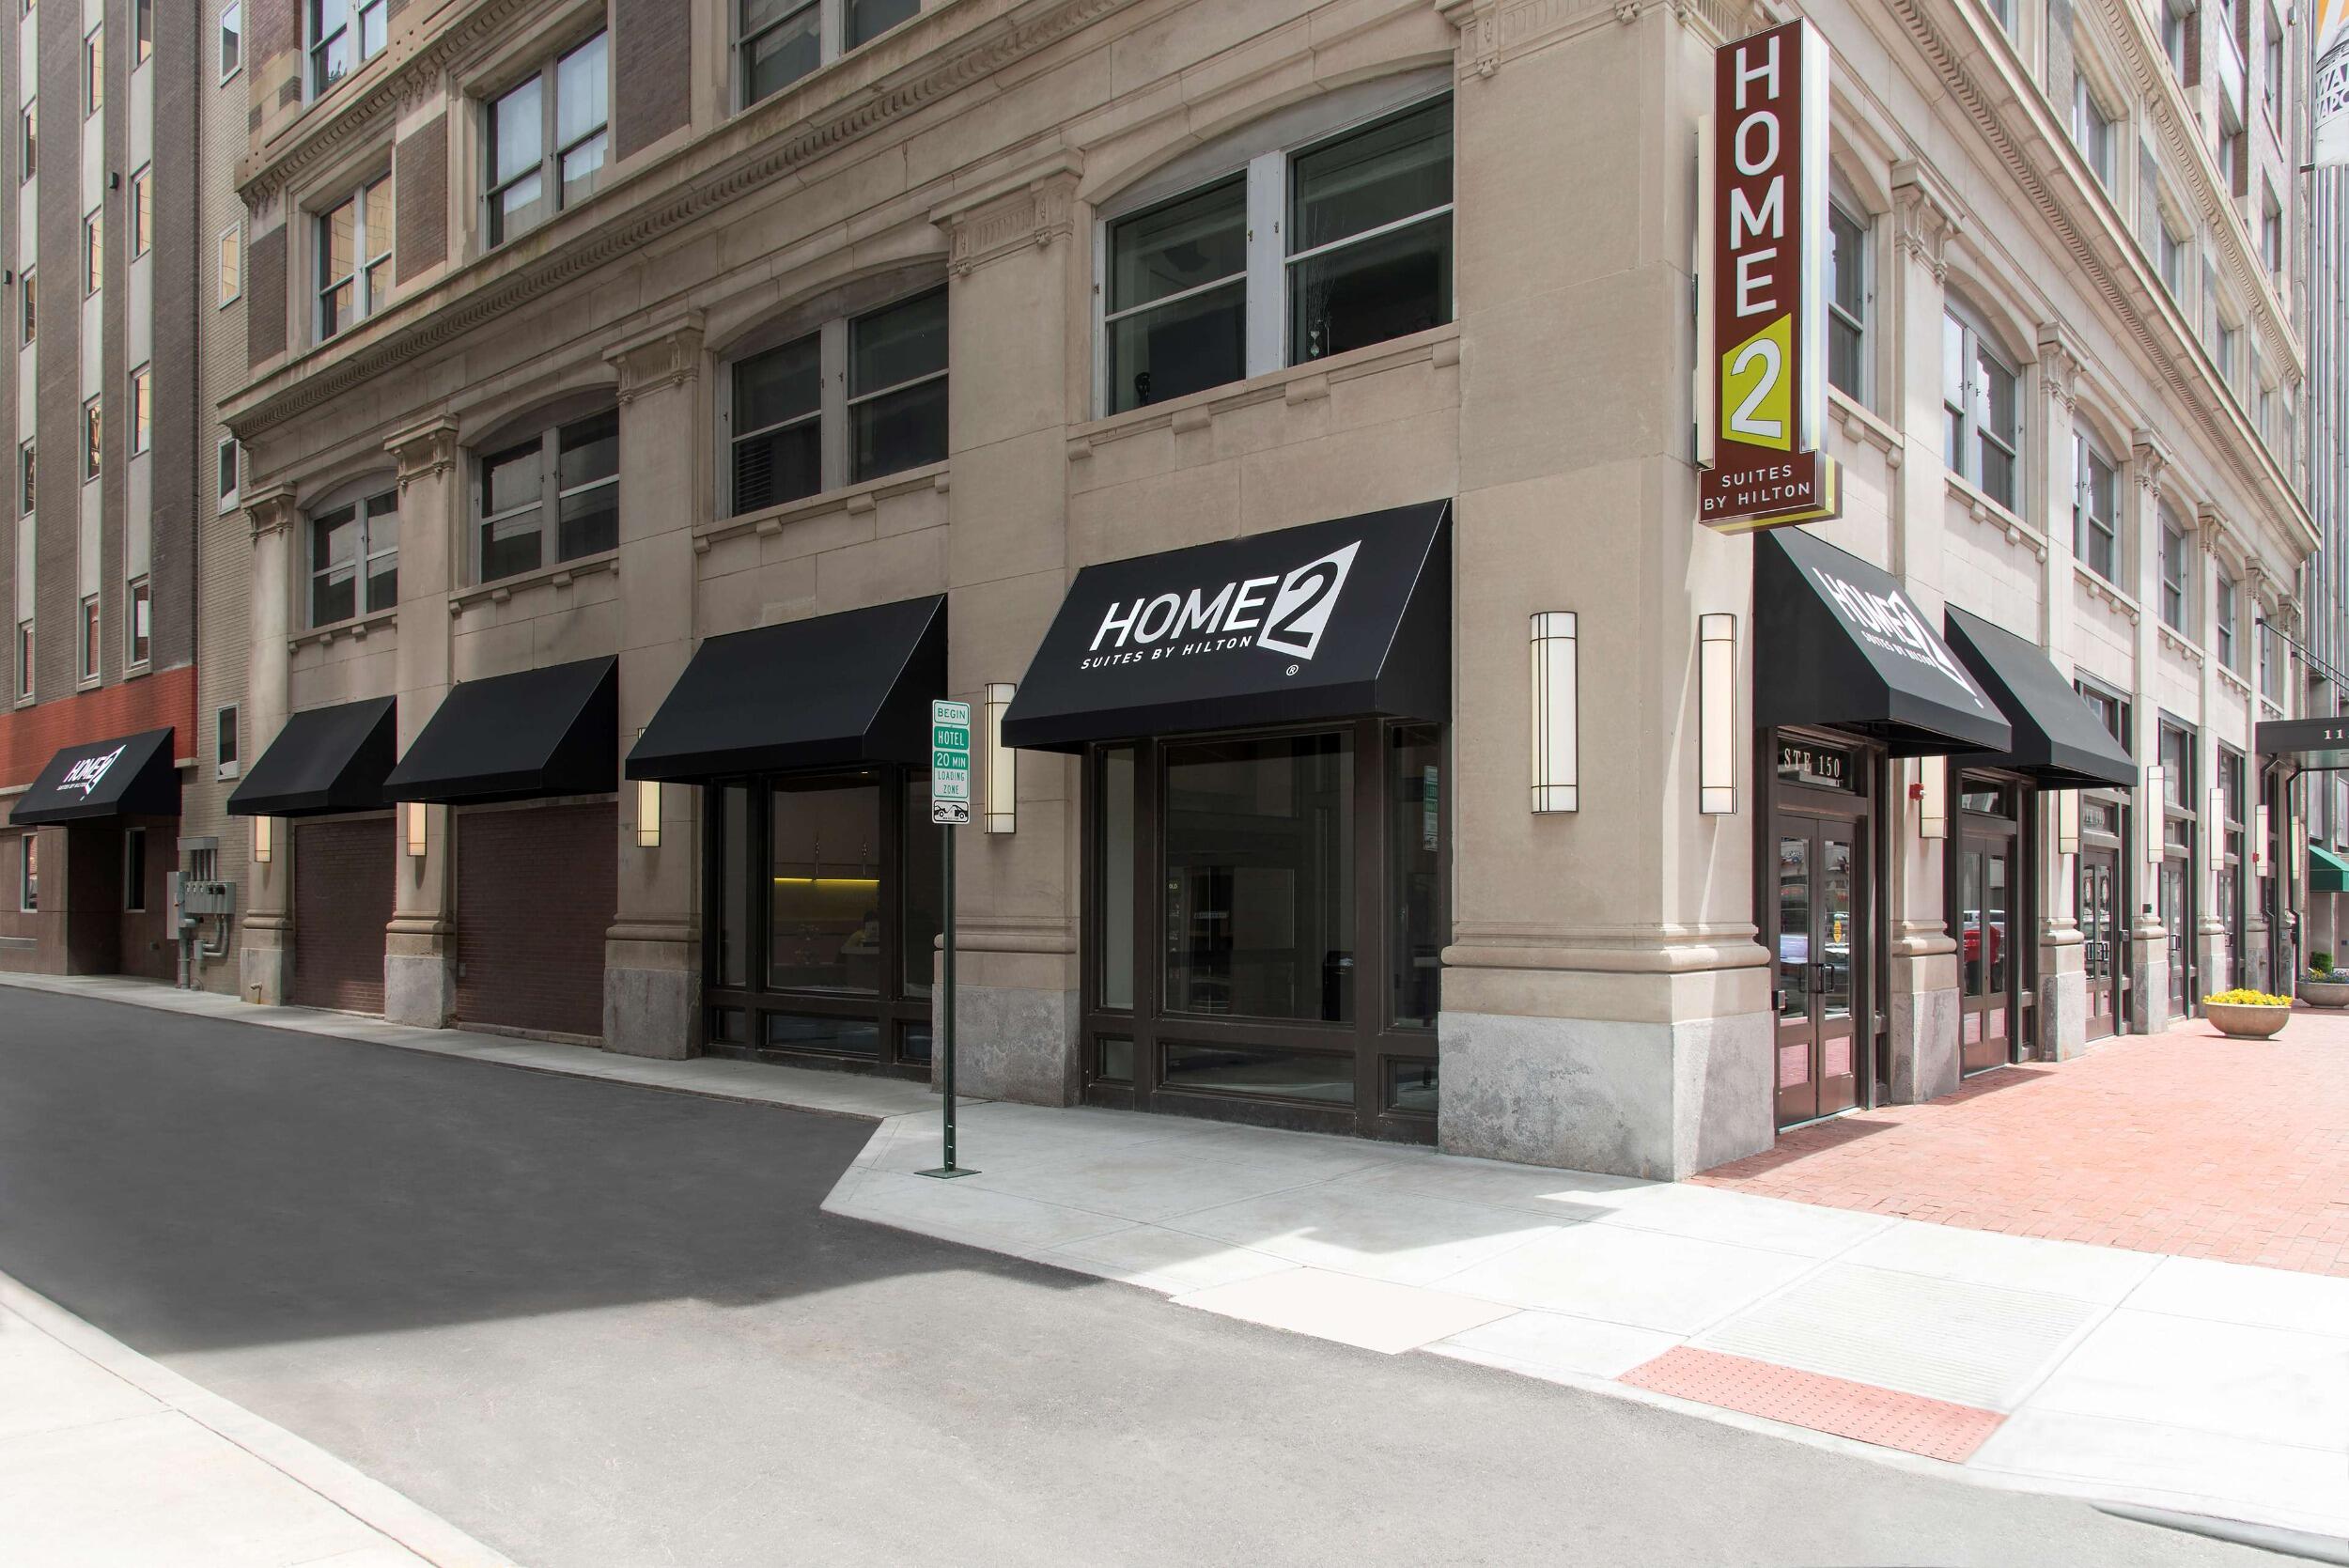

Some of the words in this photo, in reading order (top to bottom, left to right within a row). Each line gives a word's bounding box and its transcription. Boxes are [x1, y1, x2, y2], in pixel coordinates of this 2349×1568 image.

[1730, 35, 1785, 318] HOME
[1721, 464, 1793, 488] SUITES
[1704, 495, 1727, 510] BY
[1737, 481, 1811, 505] HILTON
[1081, 651, 1143, 670] SUITES
[1151, 646, 1174, 660] BY
[1182, 635, 1252, 655] HILTON
[937, 706, 966, 720] BEGIN
[938, 730, 964, 746] HOTEL
[2324, 729, 2349, 740] 11
[937, 752, 950, 767] 20
[952, 756, 966, 768] MIN
[1784, 748, 1811, 772] STE
[1819, 754, 1841, 778] 150
[938, 770, 965, 782] LOADING
[943, 784, 959, 795] ZONE
